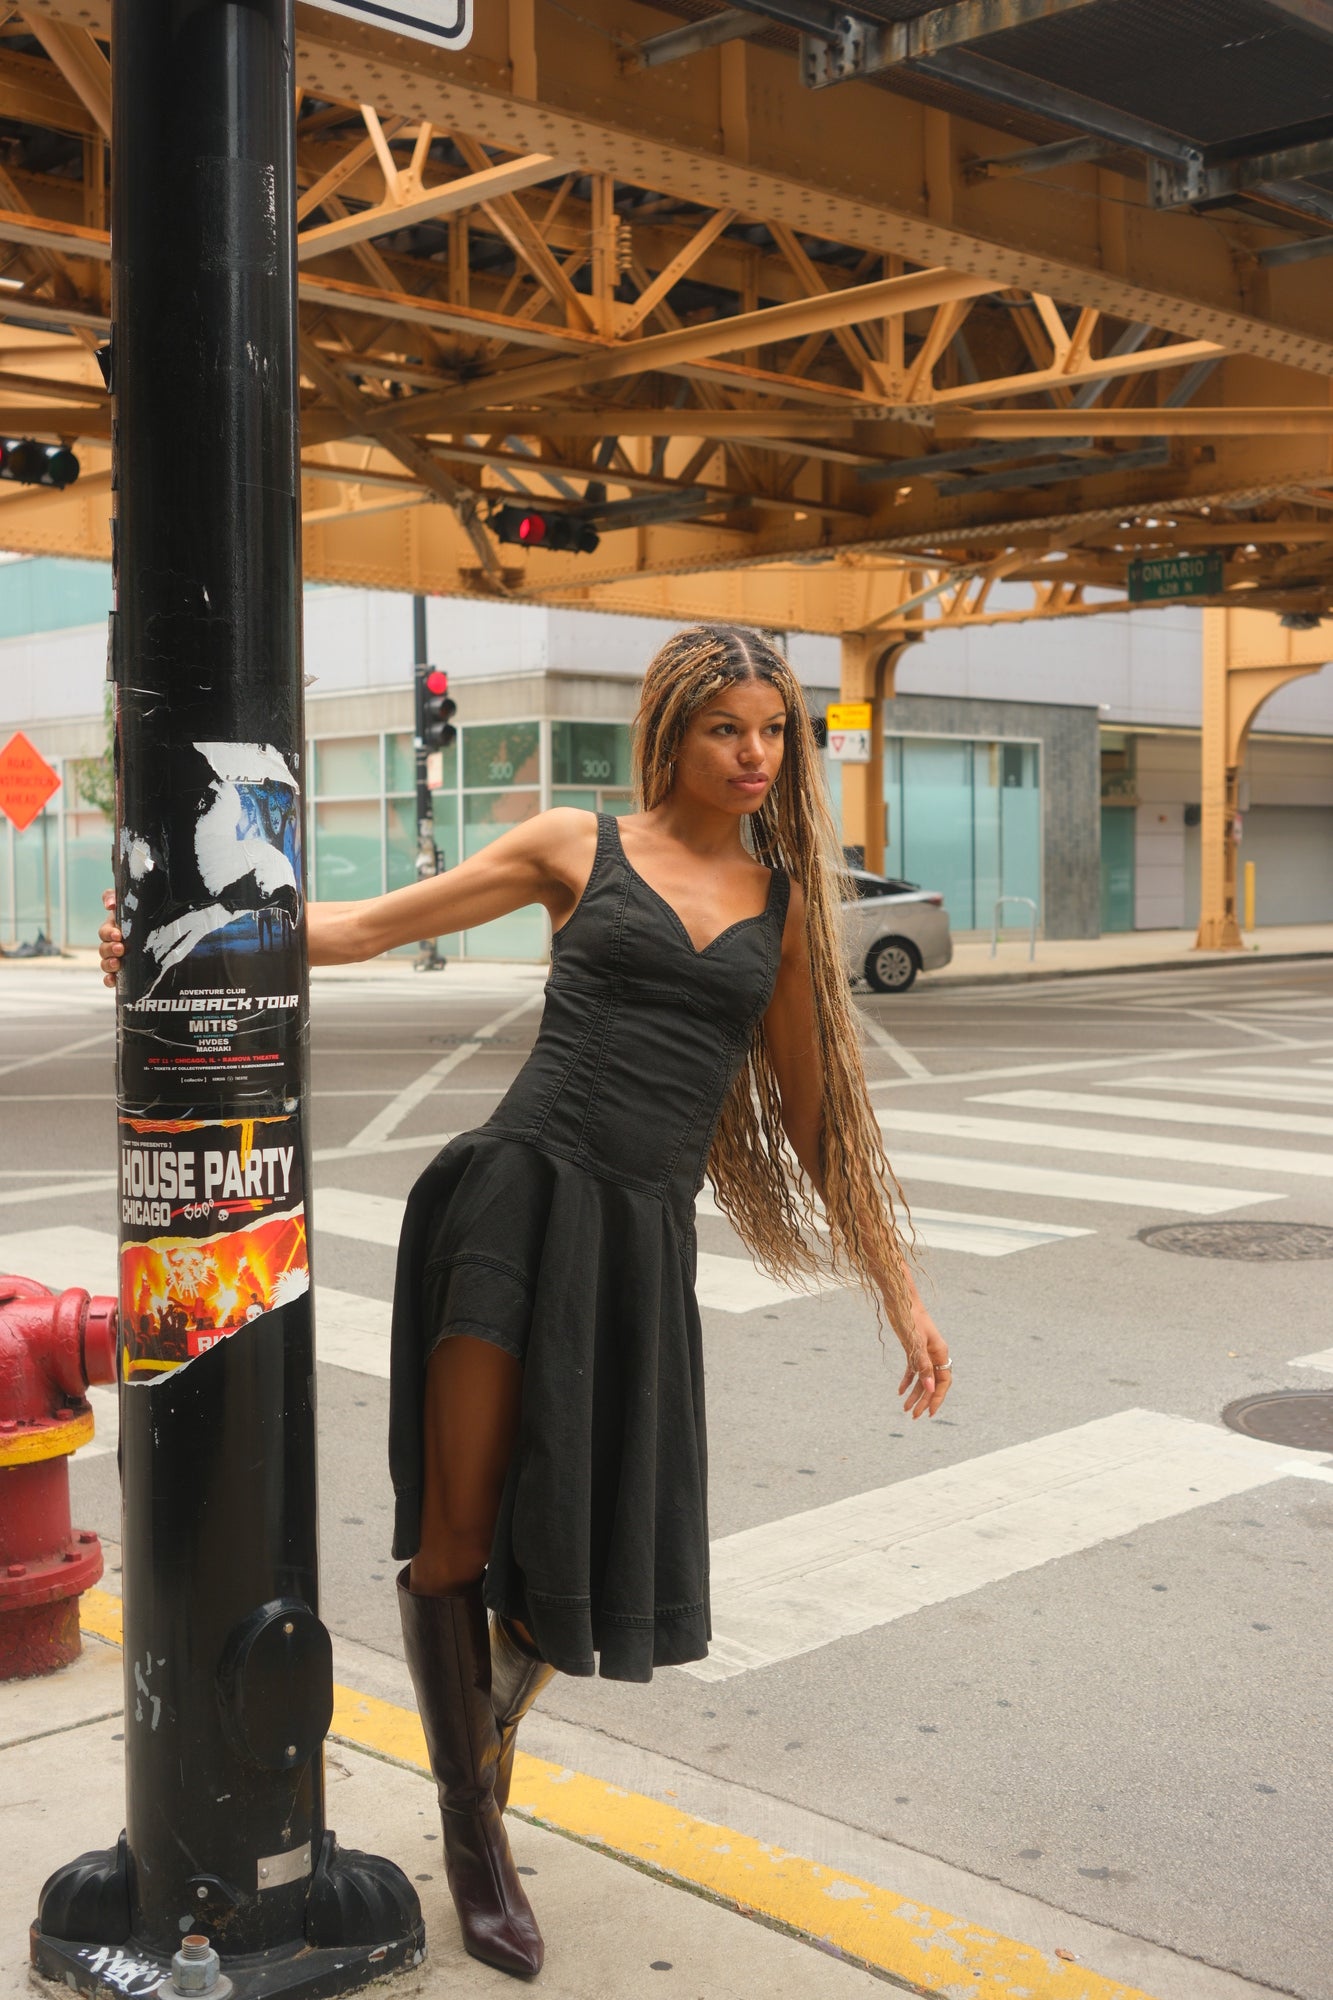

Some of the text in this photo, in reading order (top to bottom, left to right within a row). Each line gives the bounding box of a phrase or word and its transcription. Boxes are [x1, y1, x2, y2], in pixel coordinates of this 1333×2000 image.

[1142, 560, 1204, 582] ONTARIO
[1184, 582, 1194, 593] N
[7, 758, 33, 770] ROAD
[488, 761, 514, 780] 300
[582, 760, 610, 778] 300
[5, 792, 38, 805] AHEAD
[255, 995, 299, 1010] TOUR
[189, 1019, 238, 1032] MITIS
[121, 1145, 294, 1200] HOUSE PARTY
[122, 1198, 171, 1227] CHICAGO
